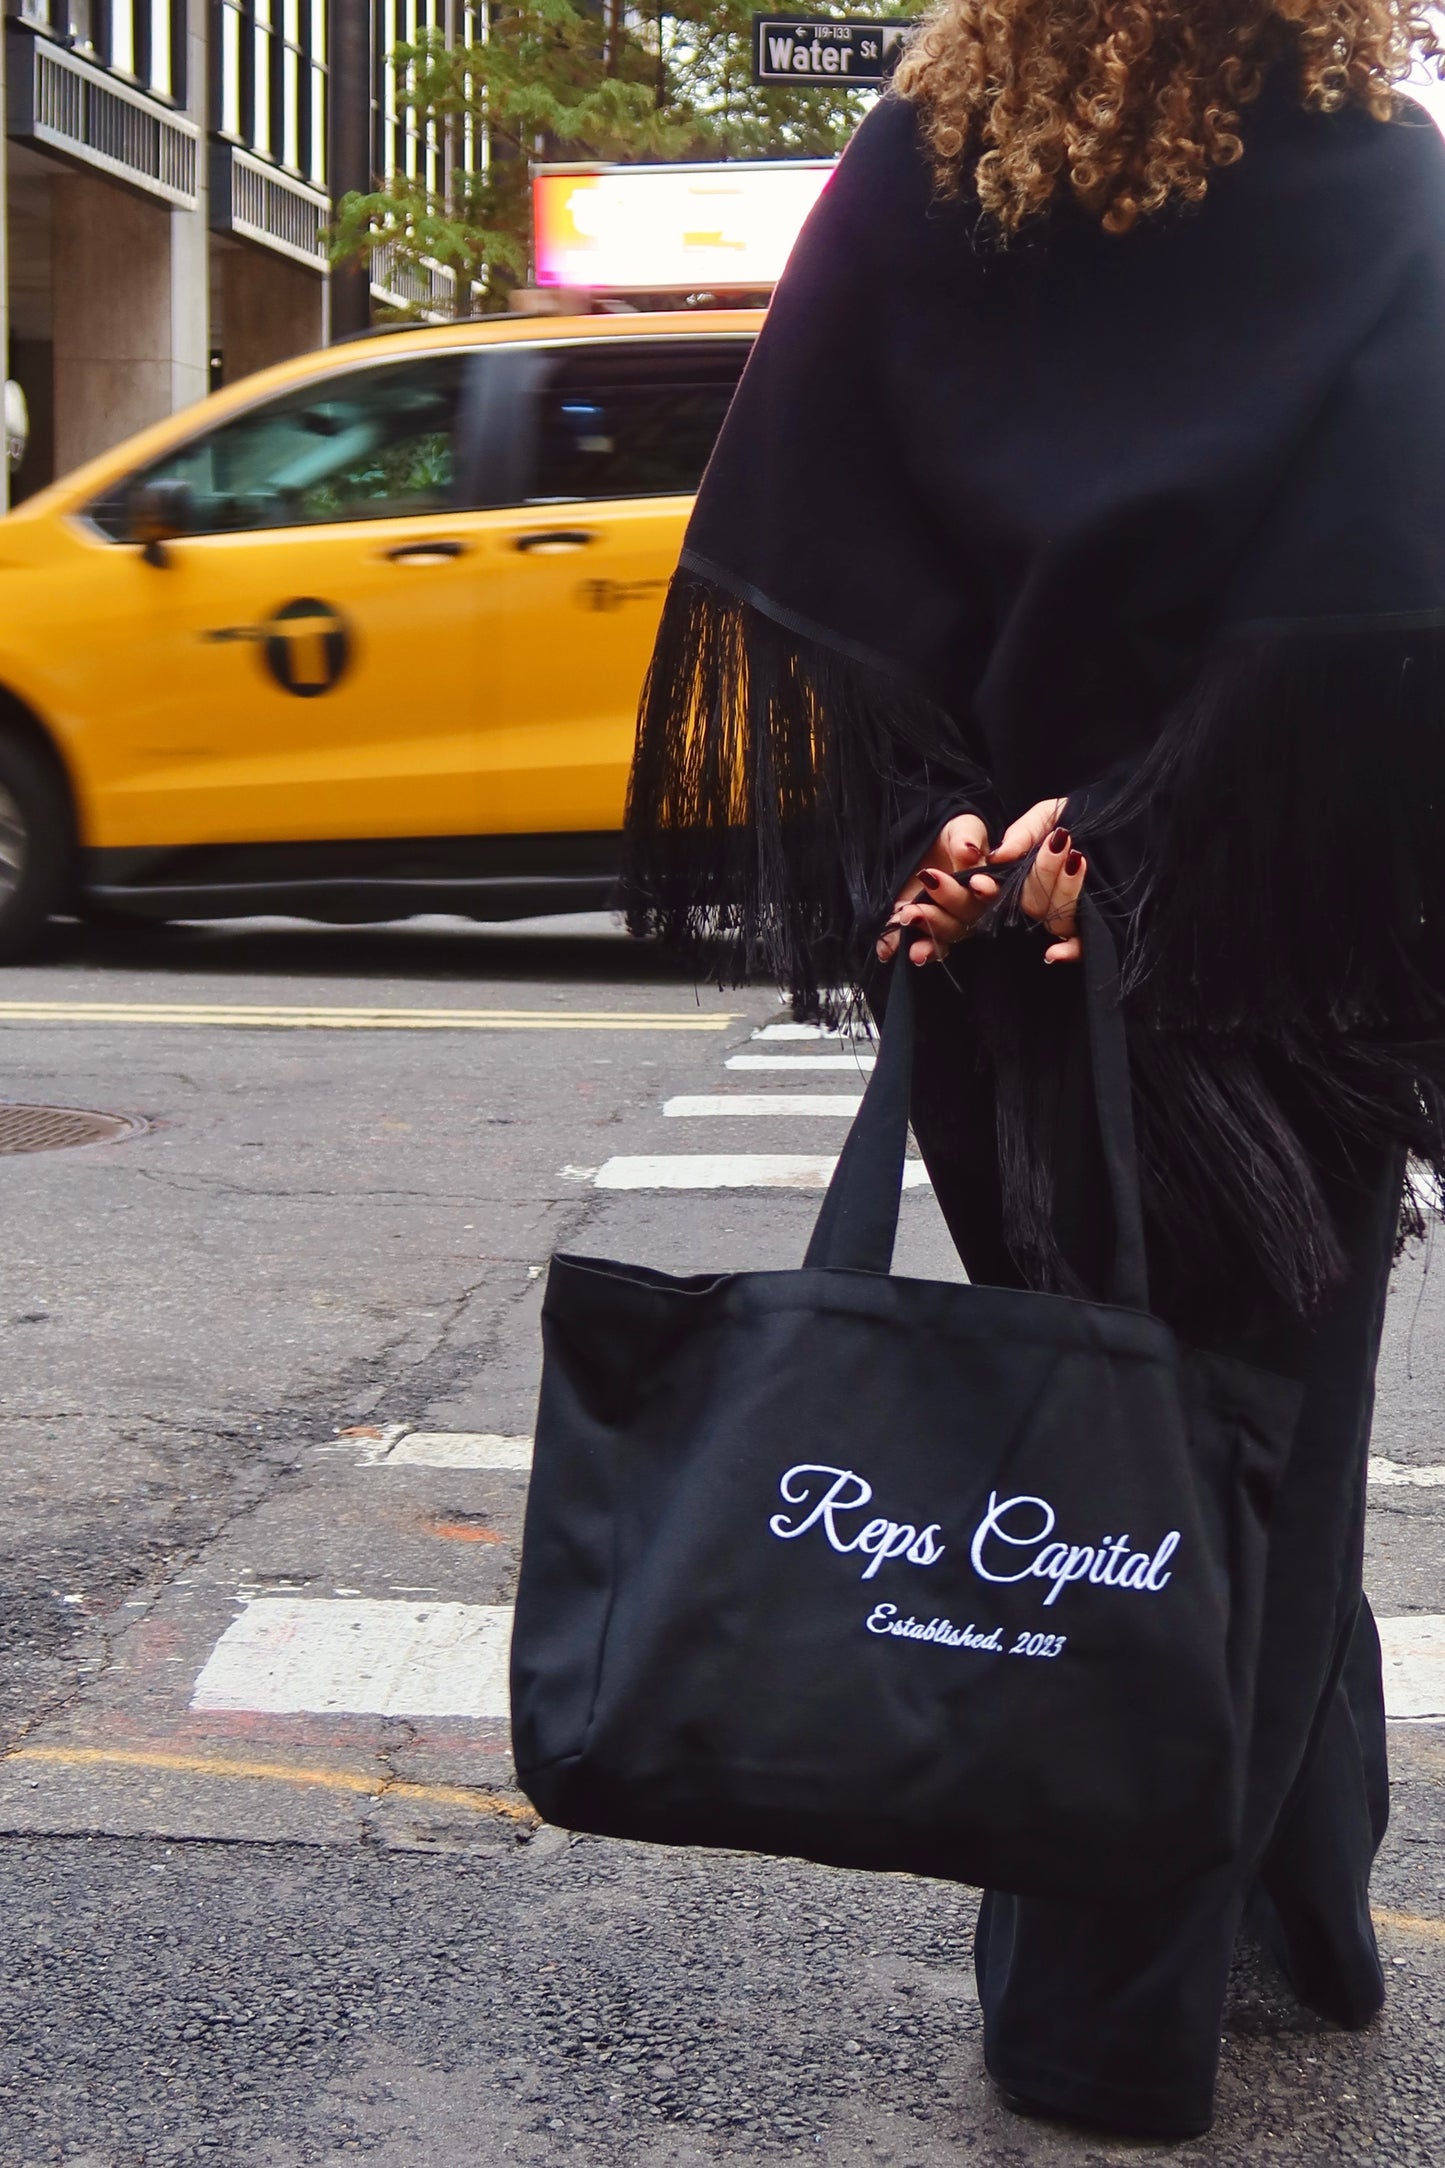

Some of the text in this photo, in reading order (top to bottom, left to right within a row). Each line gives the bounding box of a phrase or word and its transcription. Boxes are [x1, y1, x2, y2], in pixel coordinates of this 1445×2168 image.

[768, 37, 878, 73] Water St
[814, 26, 851, 39] 119-133
[769, 1464, 1181, 1606] Reps Capital
[866, 1603, 1067, 1657] Established. 2023
